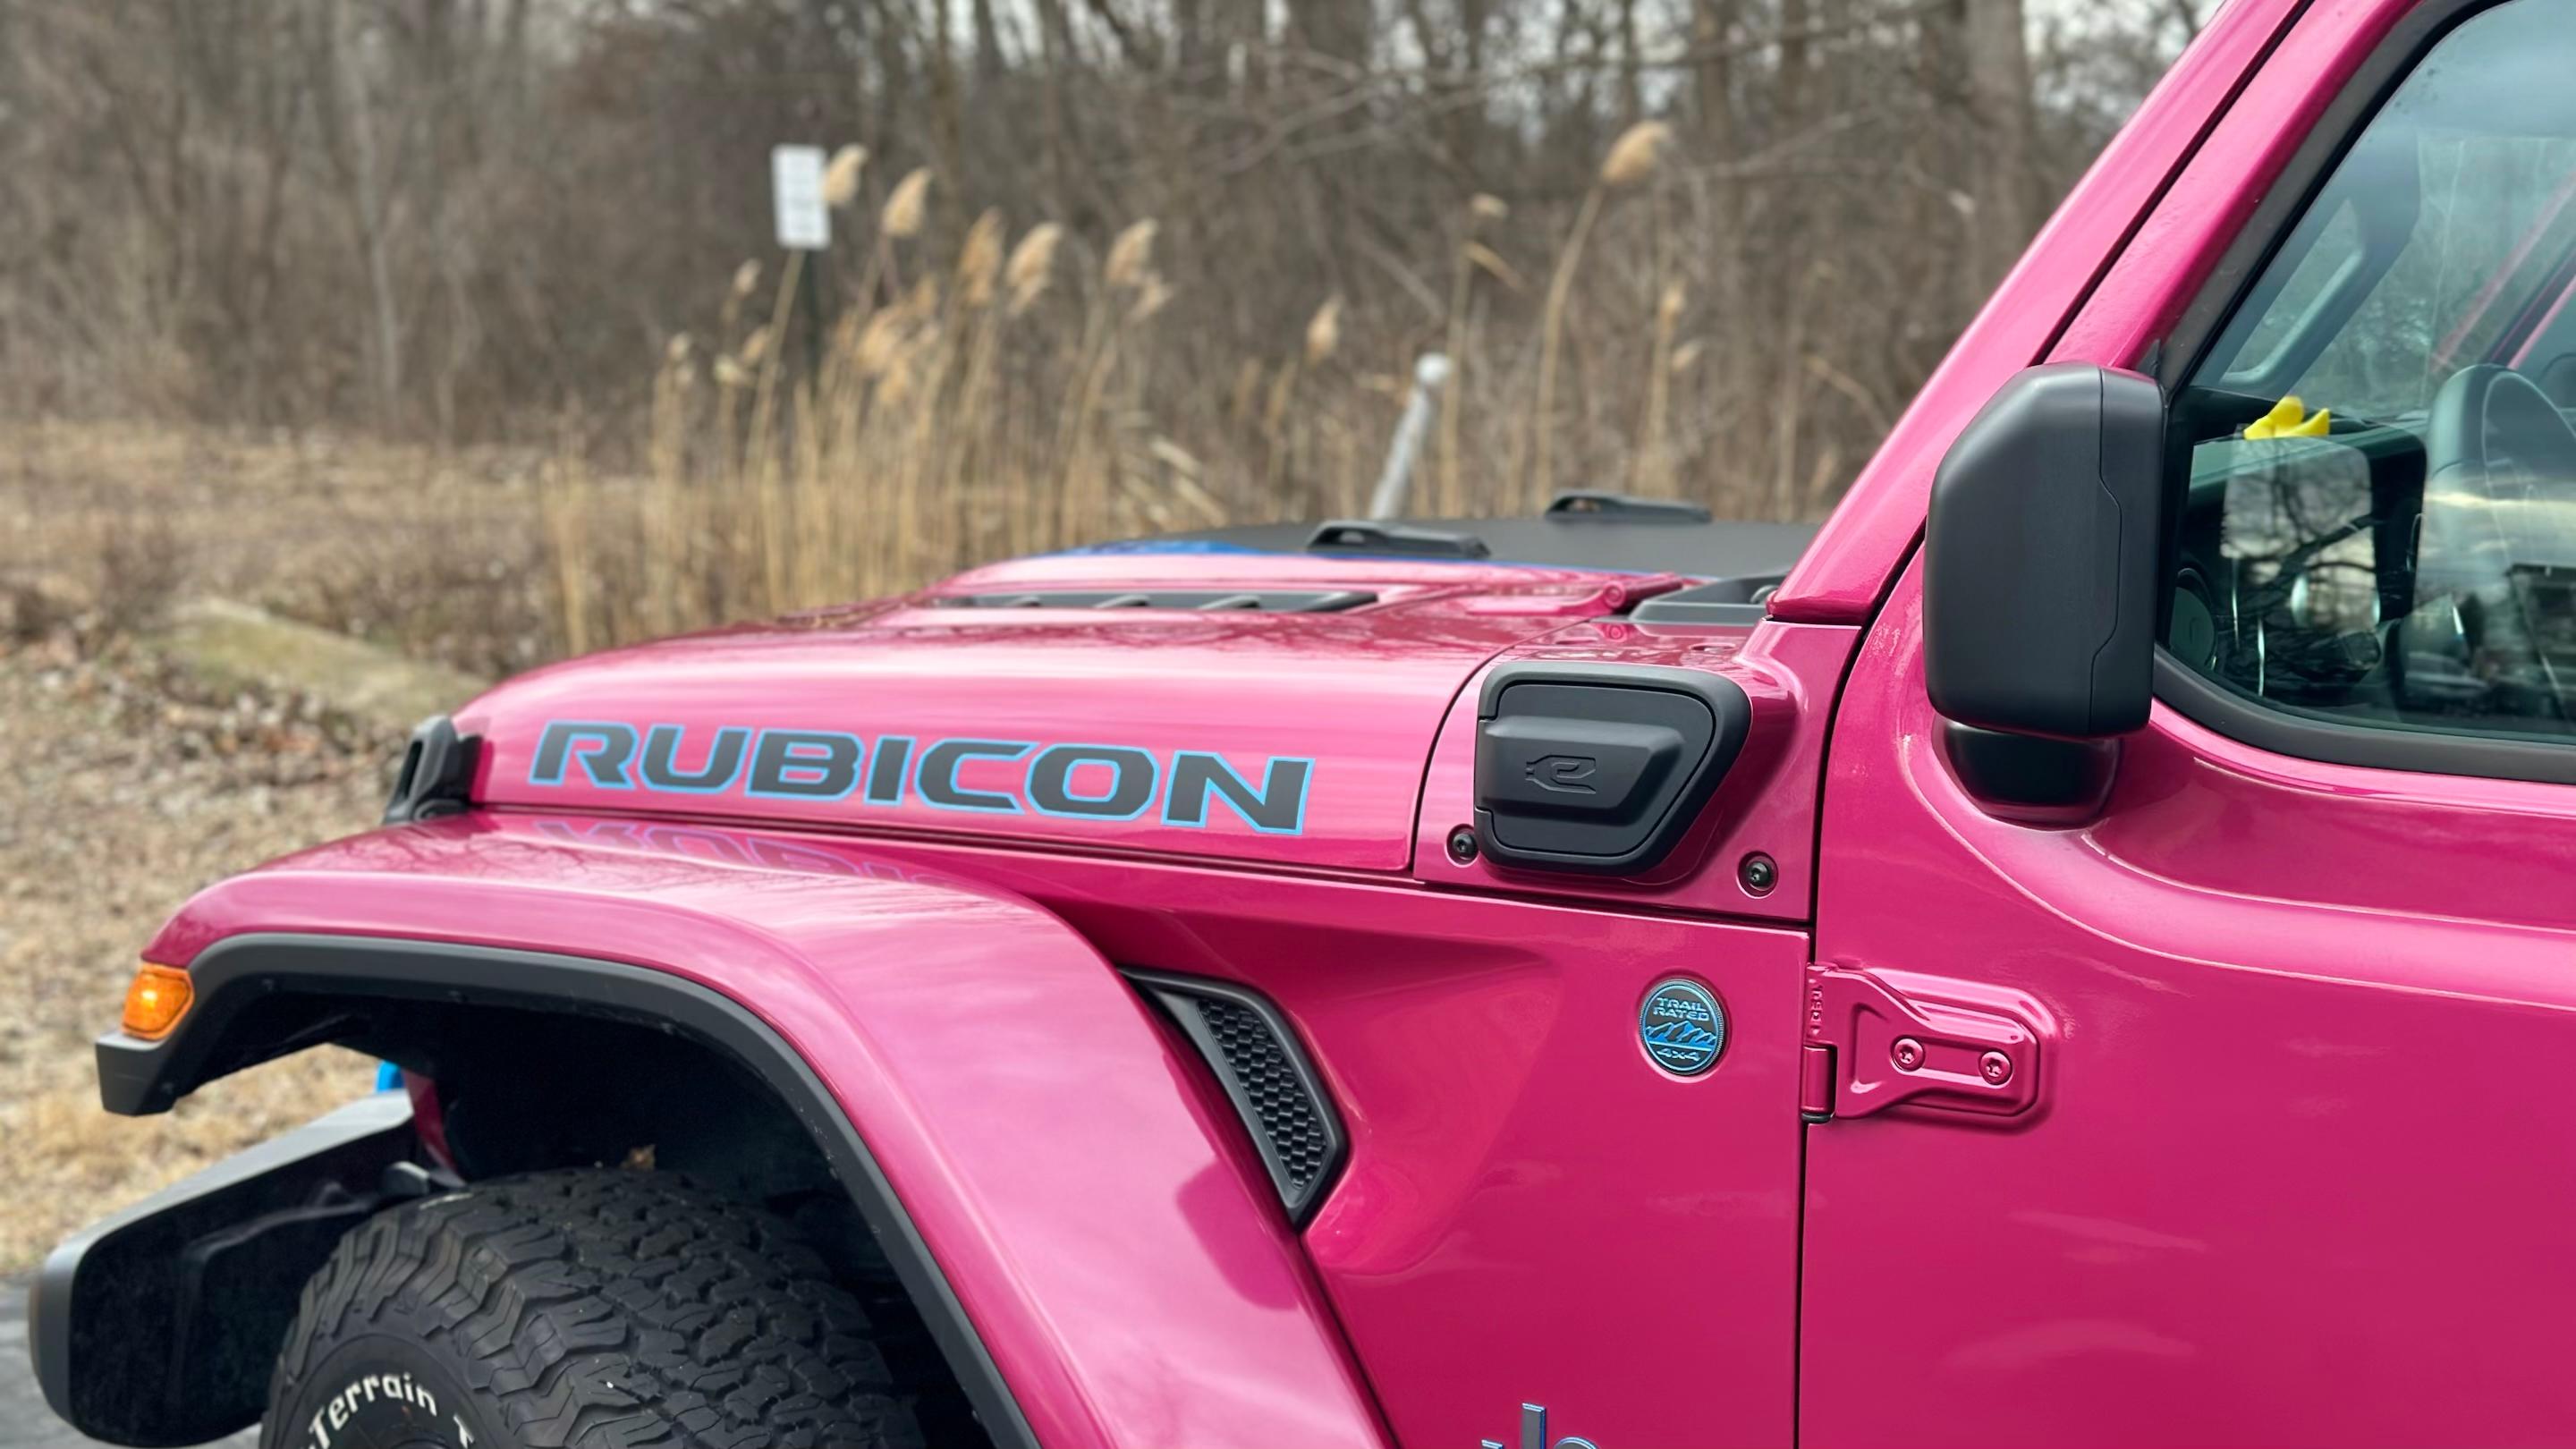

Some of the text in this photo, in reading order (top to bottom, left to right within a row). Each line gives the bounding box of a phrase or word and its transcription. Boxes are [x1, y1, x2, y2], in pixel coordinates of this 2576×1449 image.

[529, 720, 1316, 835] RUBICON
[1656, 997, 1707, 1013] TRAIL
[1653, 1006, 1710, 1021] RATED
